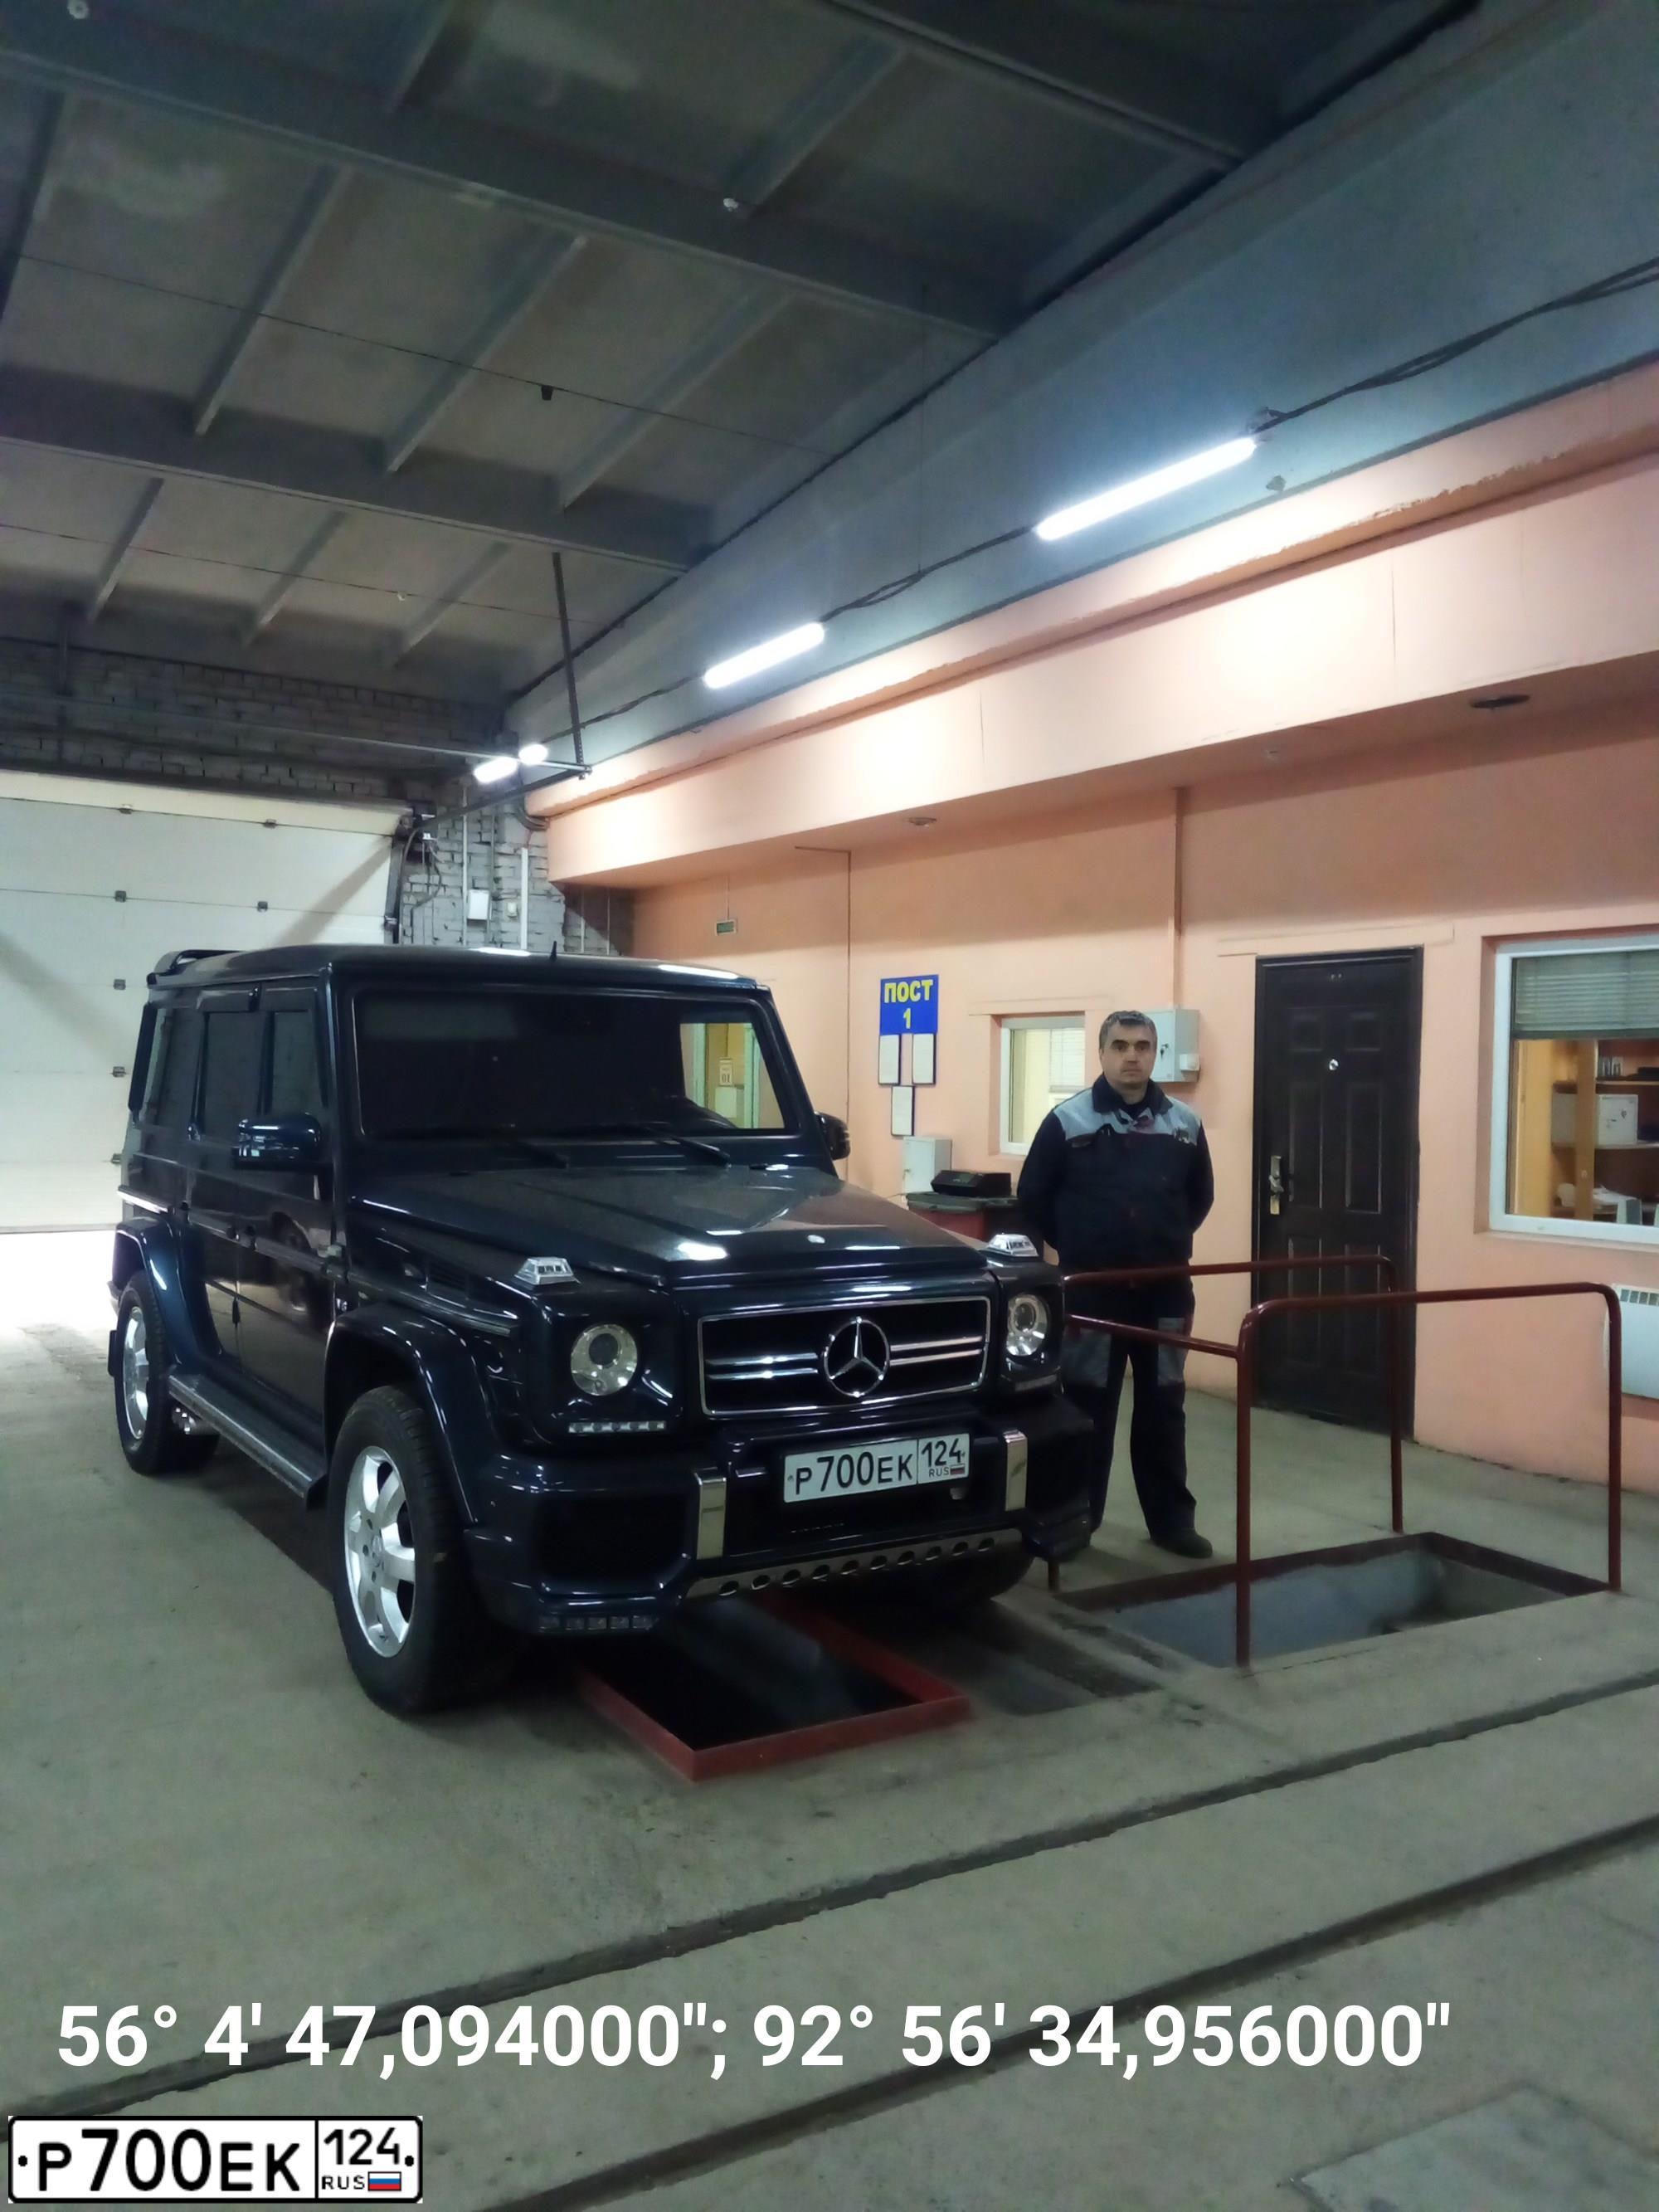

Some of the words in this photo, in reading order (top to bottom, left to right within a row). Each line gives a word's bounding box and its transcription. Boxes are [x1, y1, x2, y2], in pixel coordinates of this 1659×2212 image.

[884, 979, 933, 1003] ПОСТ
[903, 1007, 912, 1029] 1
[921, 1438, 961, 1467] 124
[795, 1452, 913, 1495] Р700ЕК
[928, 1466, 950, 1478] RUS
